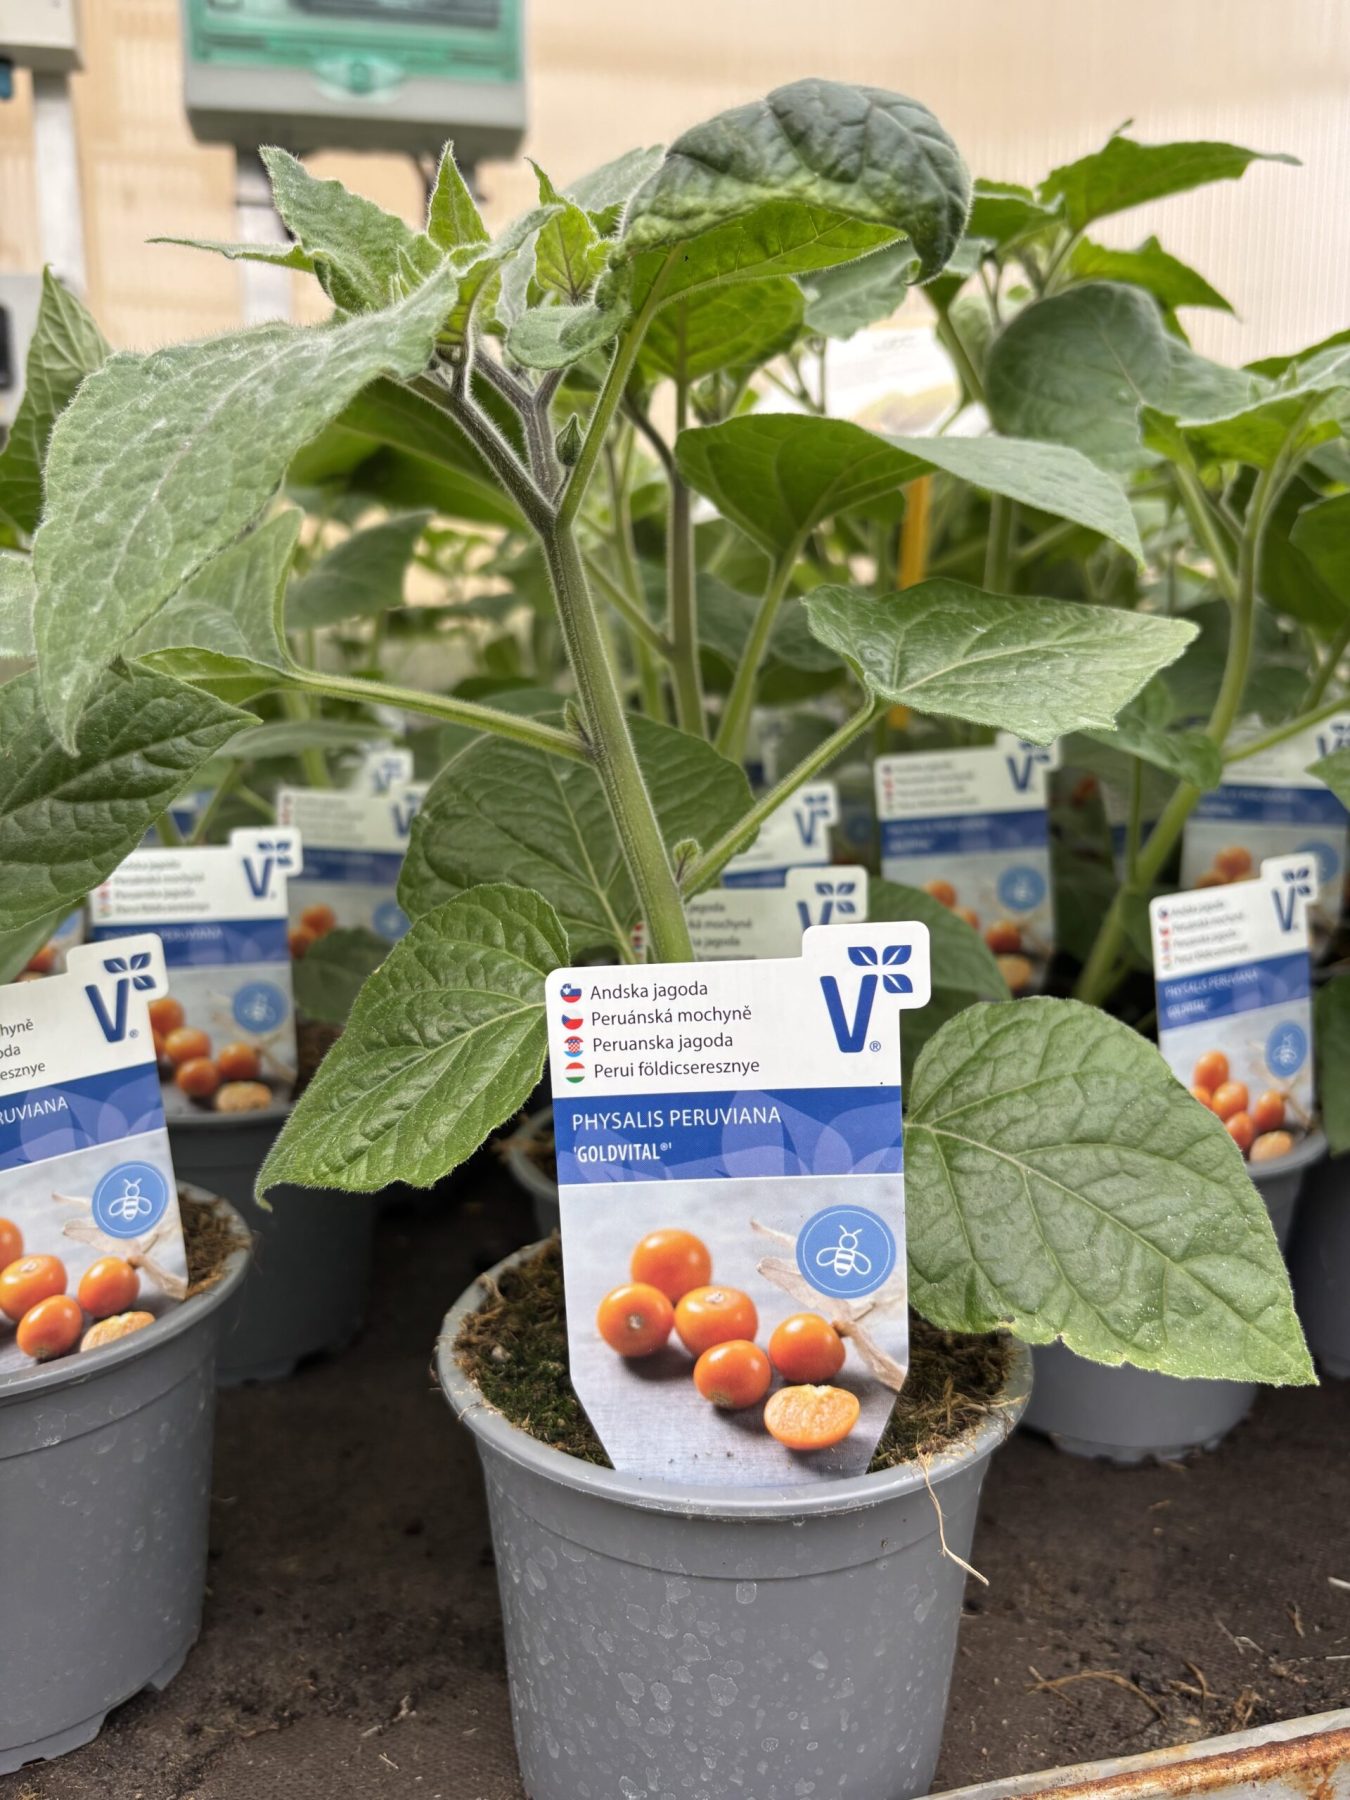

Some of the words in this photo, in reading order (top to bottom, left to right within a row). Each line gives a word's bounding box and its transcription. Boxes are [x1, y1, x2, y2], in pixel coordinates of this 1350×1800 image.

[590, 983, 649, 1000] Andska
[652, 981, 708, 1001] jagoda
[592, 1007, 673, 1026] Peruánská
[678, 1005, 752, 1024] mochyně
[593, 1034, 674, 1052] Peruanska
[678, 1032, 733, 1052] jagoda
[594, 1062, 634, 1078] Perui
[638, 1060, 760, 1077] földicseresznye
[572, 1110, 664, 1131] PHYSALIS
[669, 1106, 782, 1127] PERUVIANA
